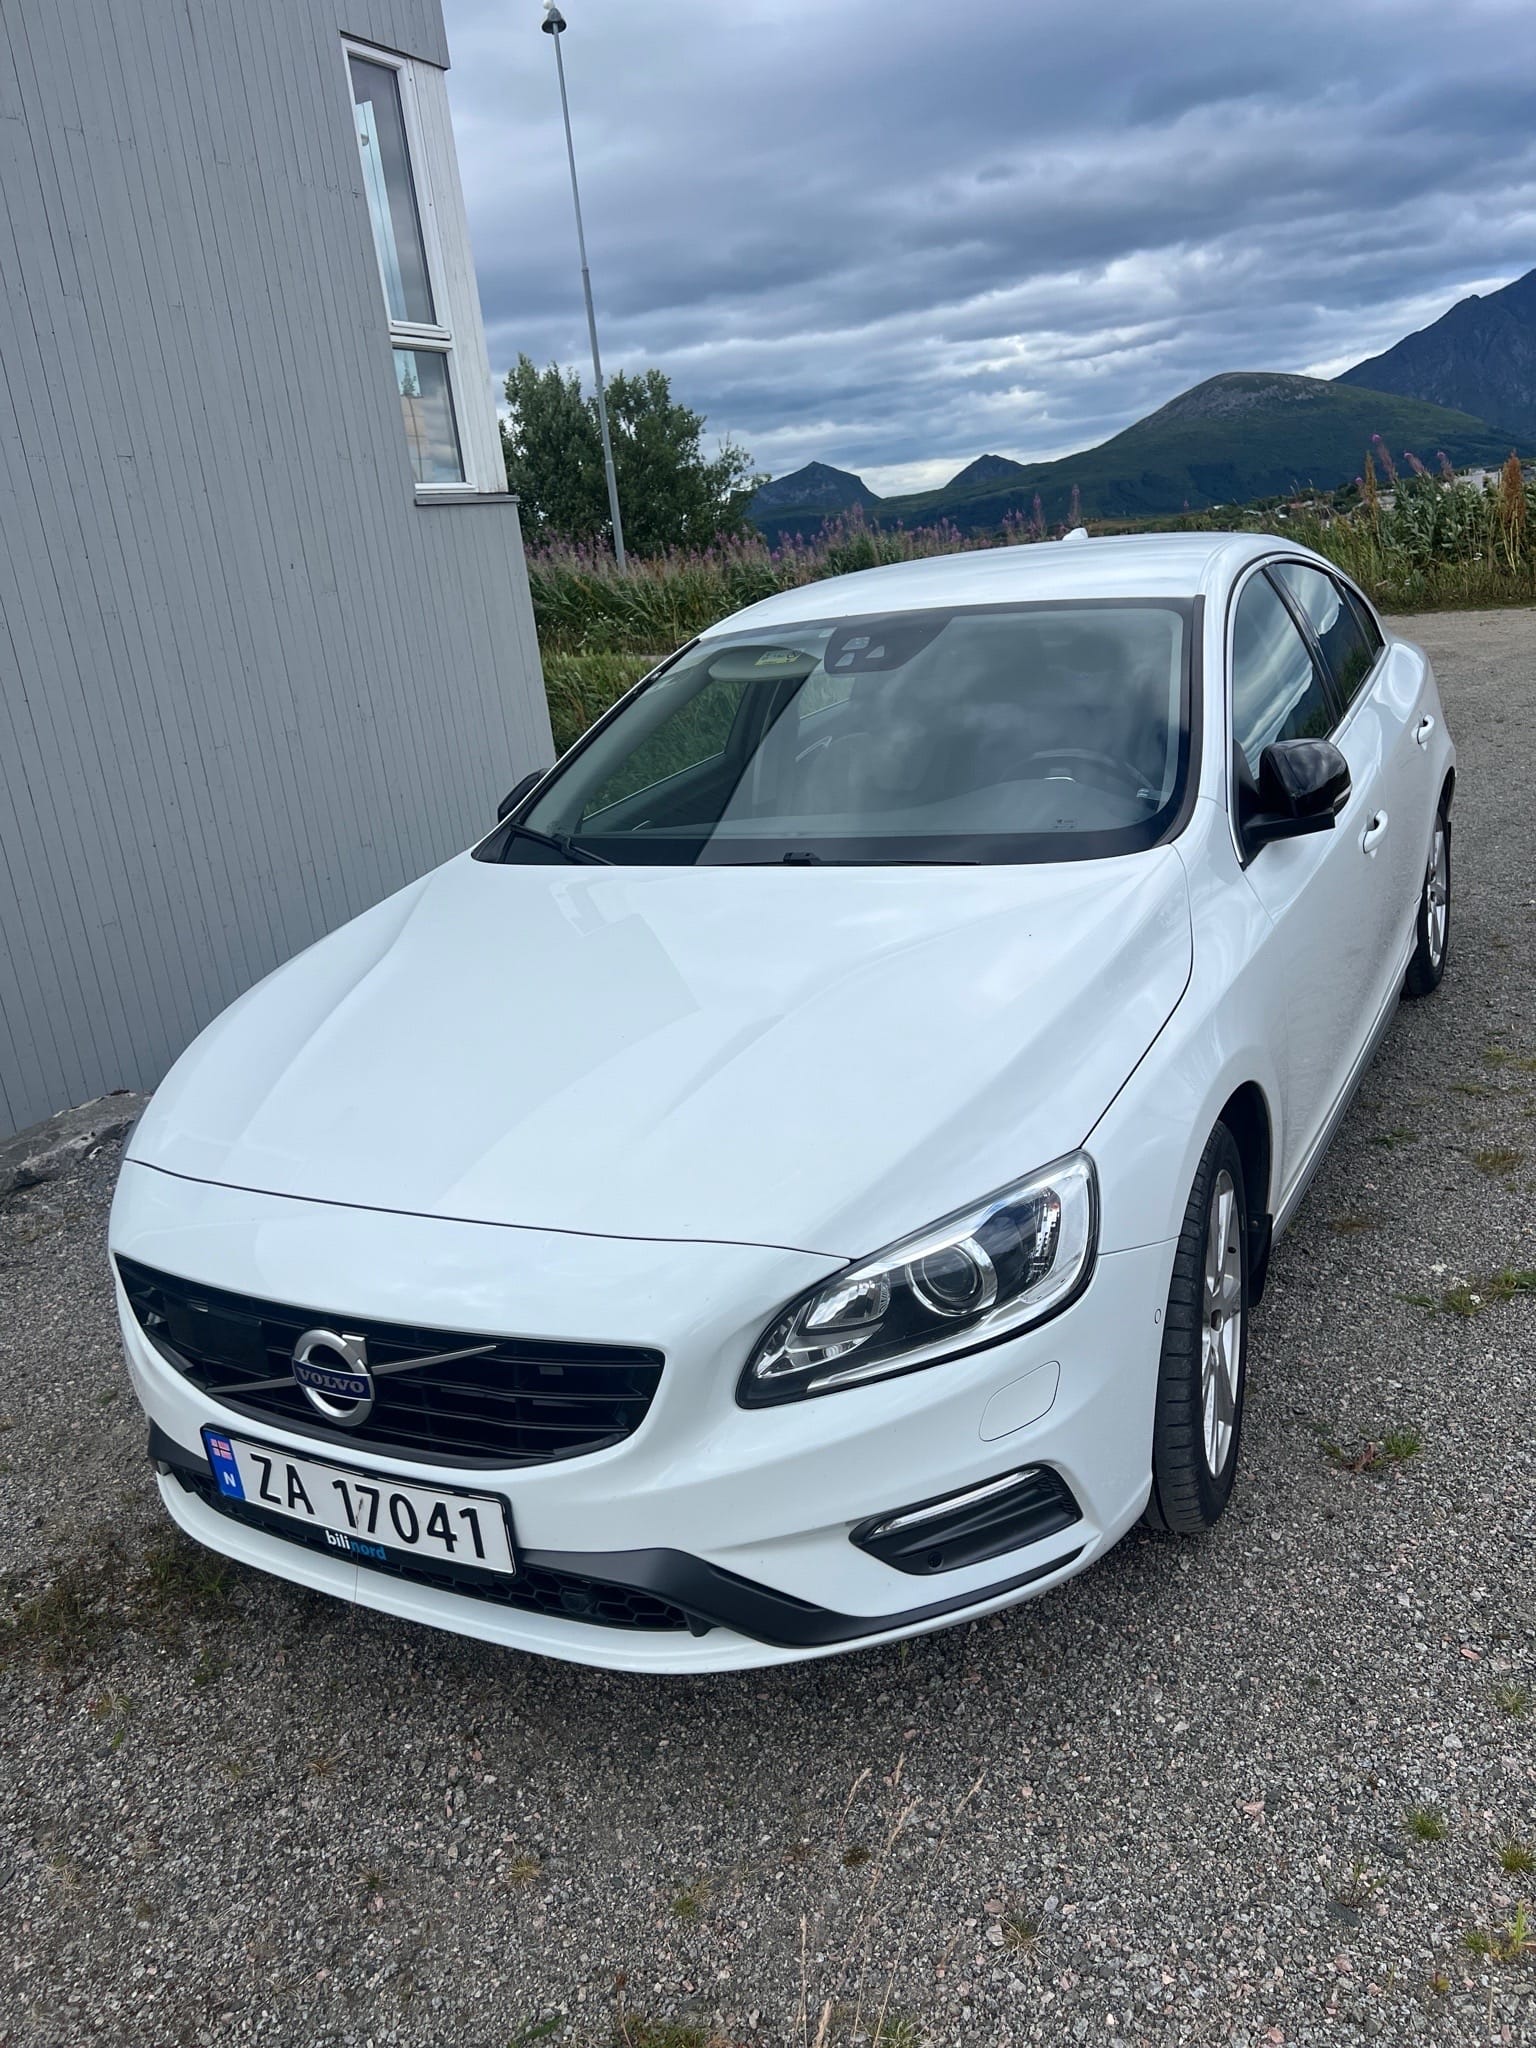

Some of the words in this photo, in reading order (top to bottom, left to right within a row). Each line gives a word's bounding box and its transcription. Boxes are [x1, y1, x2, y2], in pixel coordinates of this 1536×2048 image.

[296, 1366, 365, 1394] VOLVO
[223, 1471, 237, 1488] N
[249, 1453, 315, 1516] ZA
[331, 1478, 486, 1560] 17041
